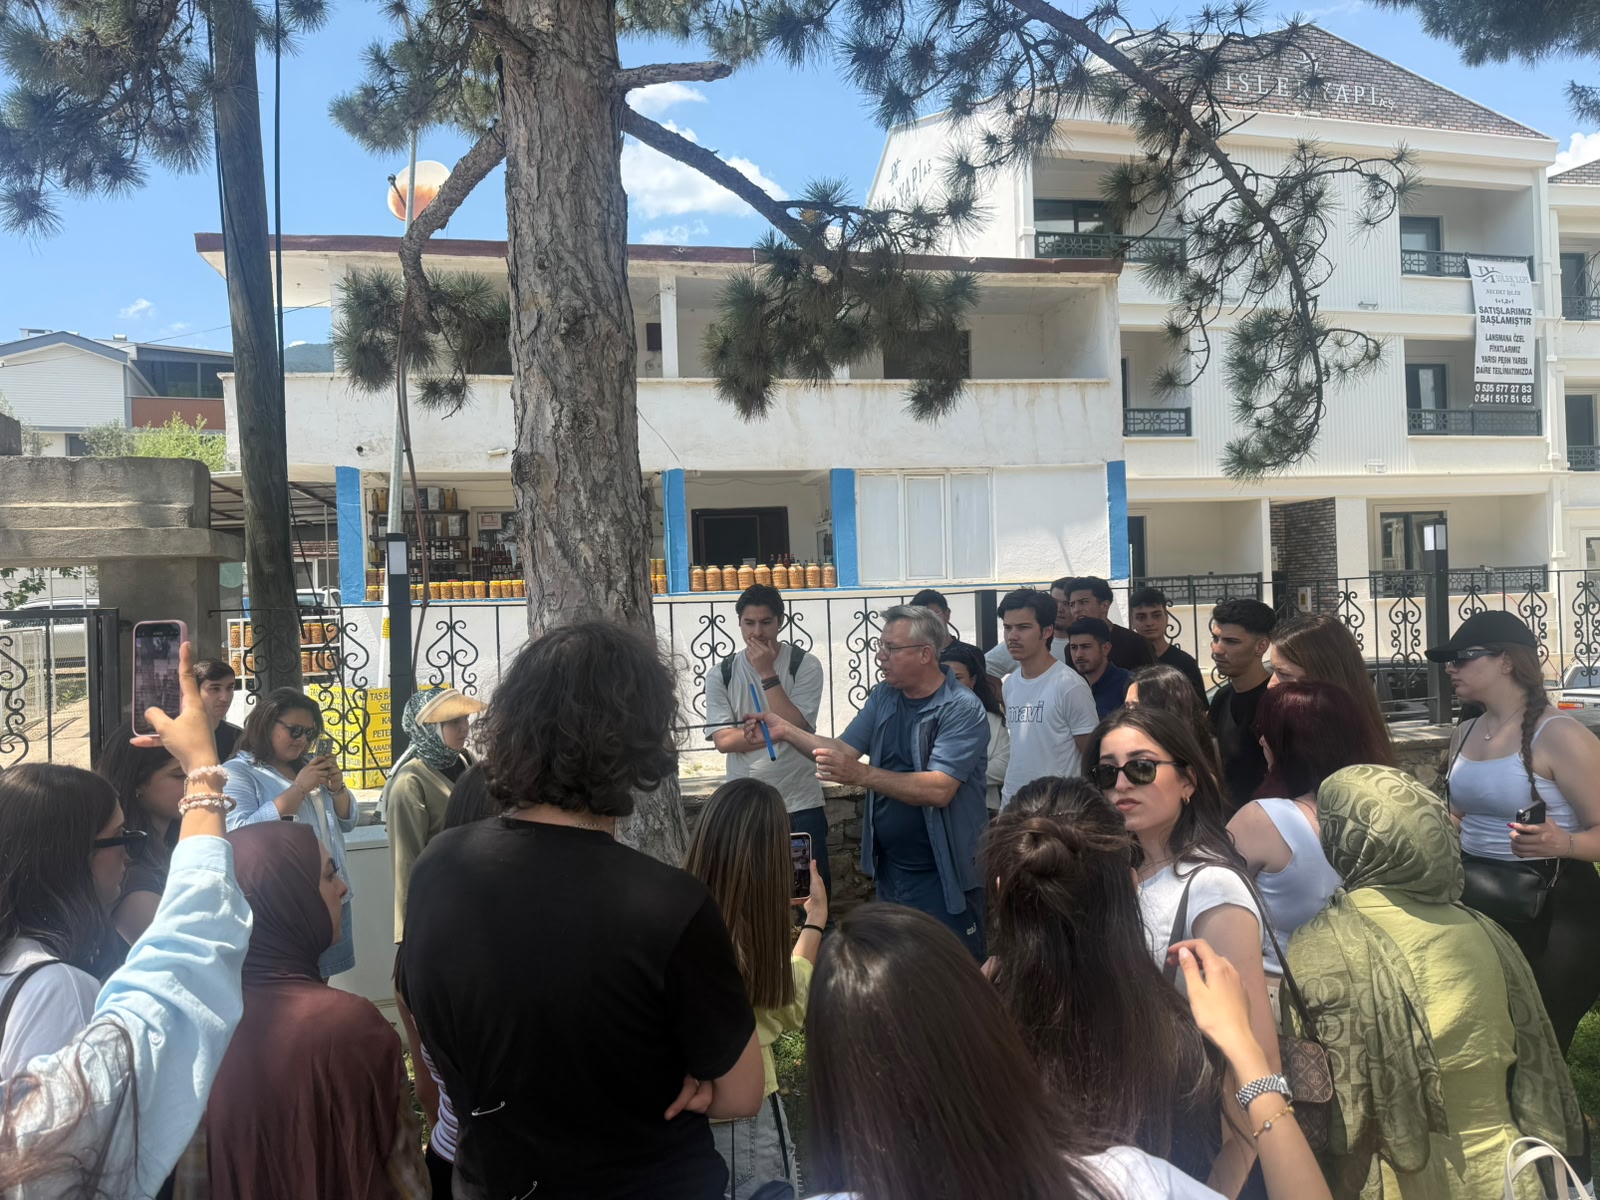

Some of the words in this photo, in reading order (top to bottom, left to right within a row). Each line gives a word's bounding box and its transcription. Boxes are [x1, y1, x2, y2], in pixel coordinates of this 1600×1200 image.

[1479, 305, 1533, 317] SATIŞLARIMIZ
[1481, 316, 1532, 327] BAŞLAMIŞTIR
[1485, 332, 1512, 342] LANSMANA
[1476, 384, 1480, 392] 0
[1495, 384, 1509, 393] 677
[1510, 384, 1520, 393] 27
[1521, 384, 1532, 394] 83
[1475, 394, 1480, 402] 0
[1480, 394, 1493, 403] 541
[1495, 394, 1509, 403] 517
[1510, 394, 1519, 403] 51
[1521, 394, 1532, 404] 65
[370, 692, 383, 703] TAŞ
[1007, 700, 1045, 724] mavi
[373, 728, 391, 738] PETE
